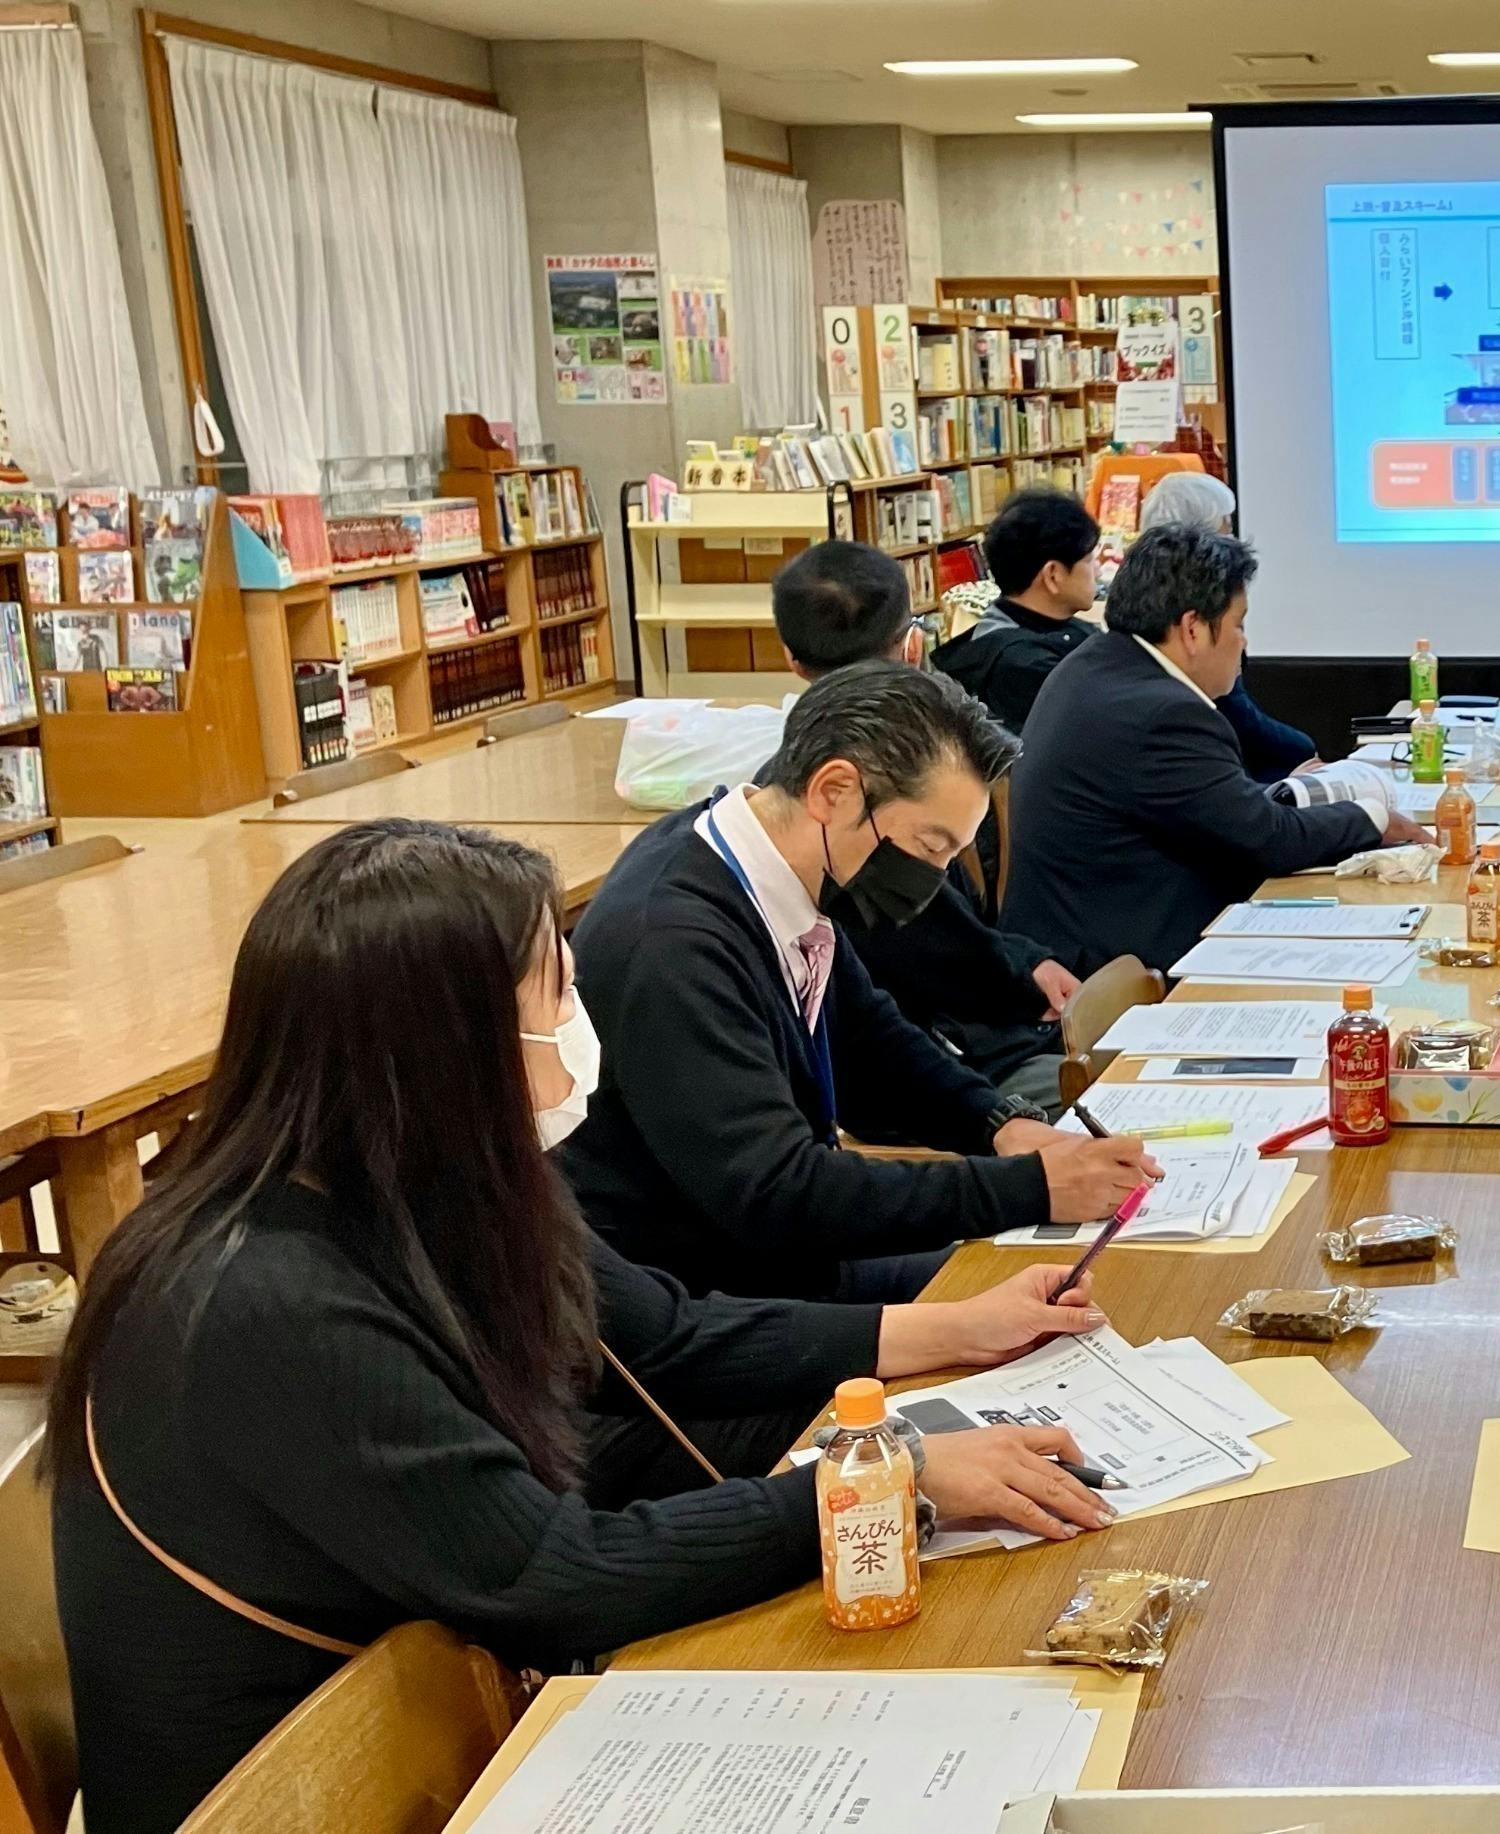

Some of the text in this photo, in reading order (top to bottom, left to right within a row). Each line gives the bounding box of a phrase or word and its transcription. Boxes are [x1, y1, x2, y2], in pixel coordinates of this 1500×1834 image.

[832, 317, 850, 344] 0
[882, 315, 902, 342] 2
[1188, 306, 1205, 335] 3
[840, 405, 851, 432] 1
[890, 402, 908, 430] 3
[1477, 911, 1491, 927] 茶
[837, 1518, 902, 1543] さんぴん
[851, 1540, 888, 1575] 茶
